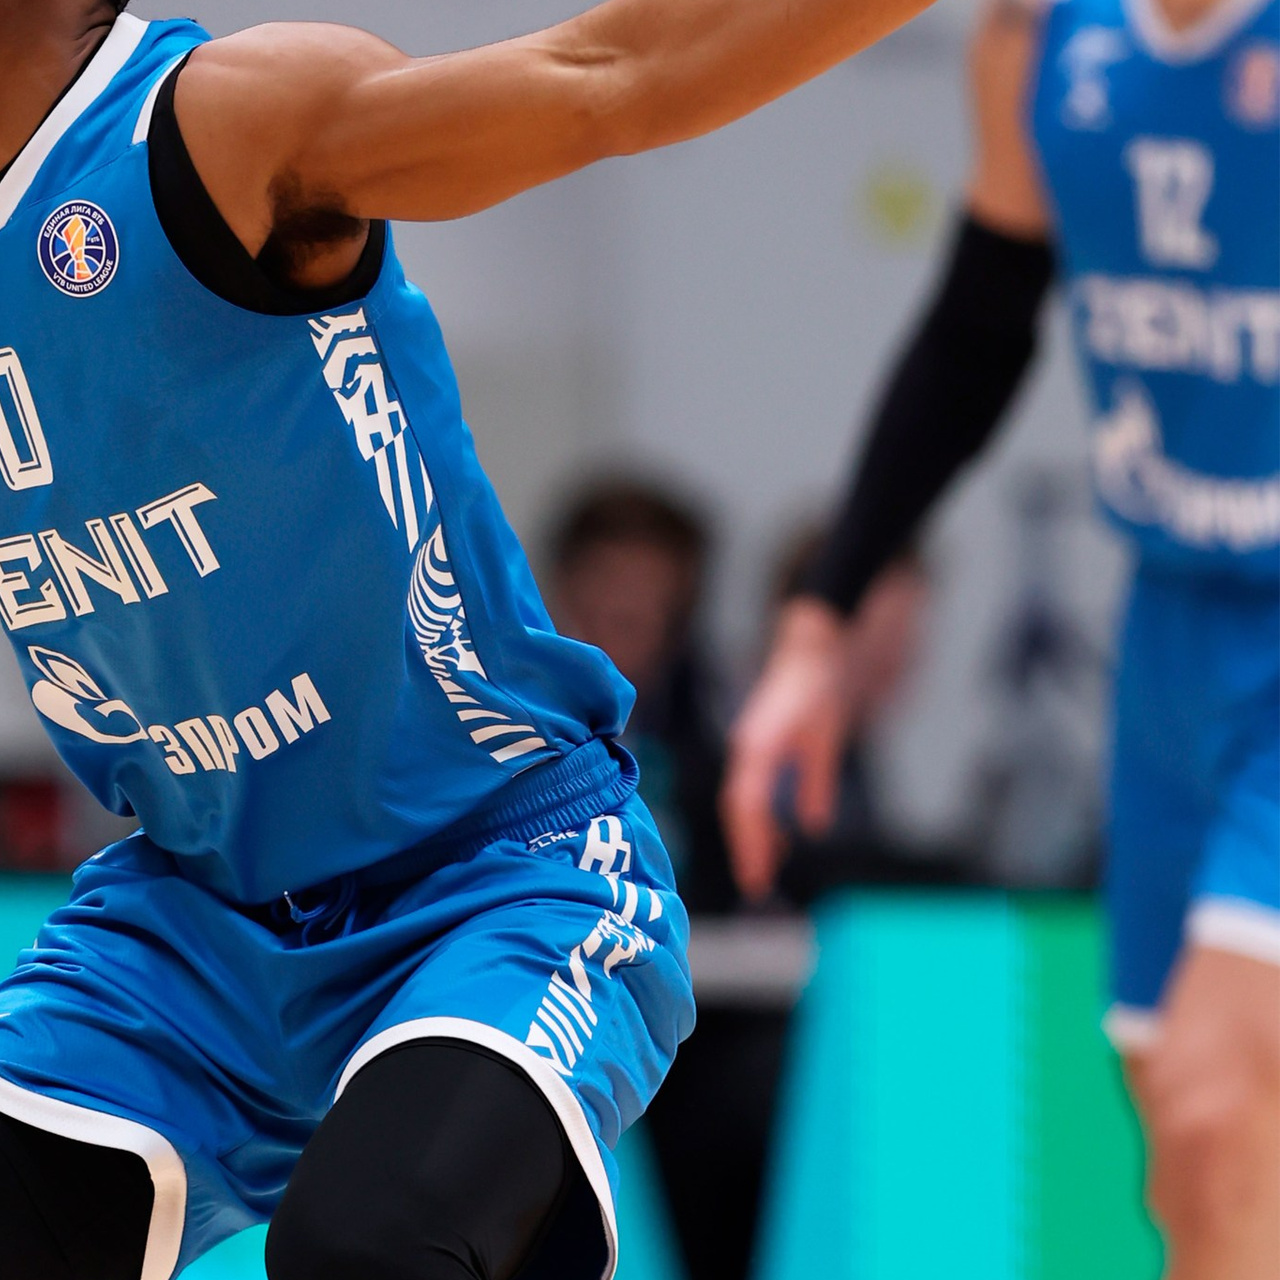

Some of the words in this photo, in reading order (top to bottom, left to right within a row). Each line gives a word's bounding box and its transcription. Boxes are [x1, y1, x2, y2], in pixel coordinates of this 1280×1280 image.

[43, 207, 70, 238] ЕДИНАЯ
[70, 205, 91, 216] ЛИГА
[91, 211, 105, 226] ВТБ
[53, 272, 65, 287] VTB
[66, 281, 94, 293] UNITED
[93, 259, 114, 286] LEAGUE
[147, 672, 332, 775] ЗПРОМ
[529, 829, 579, 854] ELME
